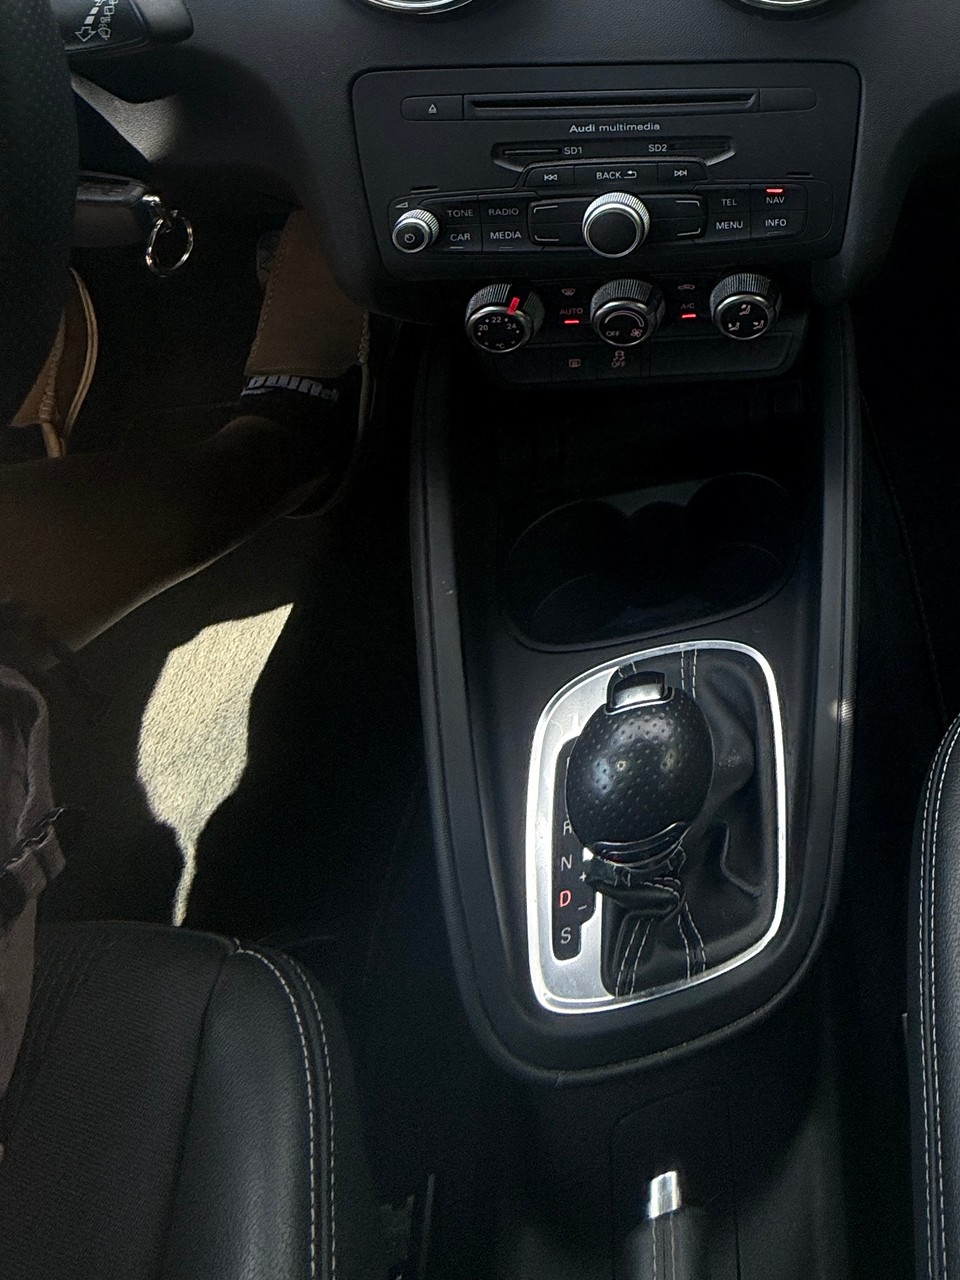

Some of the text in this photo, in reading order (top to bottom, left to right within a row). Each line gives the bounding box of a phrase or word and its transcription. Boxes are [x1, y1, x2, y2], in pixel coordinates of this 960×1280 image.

[569, 122, 660, 133] Audi multimedia
[564, 146, 583, 155] SD1
[648, 143, 667, 152] SD2
[596, 171, 622, 180] BACK
[721, 198, 737, 206] TEL
[766, 196, 785, 205] NAV
[446, 208, 474, 218] TONE
[488, 208, 519, 216] RADIO
[716, 221, 744, 230] MENU
[765, 218, 787, 227] INFO
[450, 232, 471, 241] CAR
[490, 230, 522, 240] MEDIA
[560, 307, 584, 315] AUTO
[506, 322, 517, 330] 24
[560, 854, 573, 871] N
[559, 889, 572, 907] D
[560, 926, 572, 944] S
